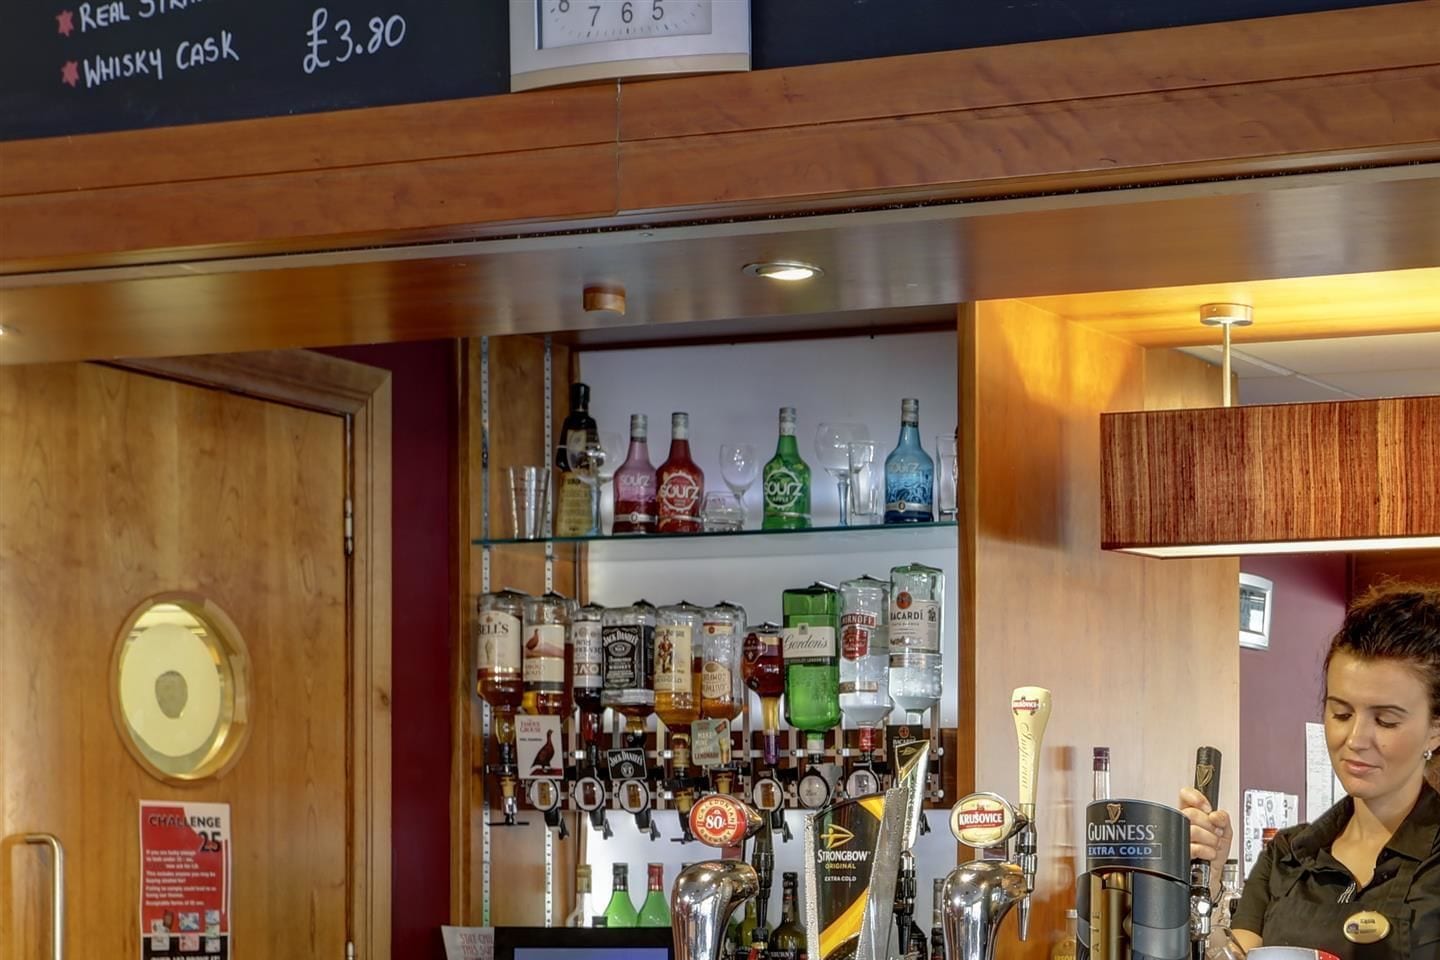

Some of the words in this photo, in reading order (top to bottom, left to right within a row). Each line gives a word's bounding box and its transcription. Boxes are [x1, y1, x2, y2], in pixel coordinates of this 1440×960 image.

[80, 2, 131, 33] REAL
[588, 6, 601, 26] 7
[621, 2, 633, 24] 6
[652, 0, 664, 21] 5
[303, 7, 406, 75] £3.80
[83, 48, 164, 89] WHISKY
[176, 30, 240, 71] CASK
[783, 631, 829, 651] Gordon's
[149, 815, 222, 829] CHALLENGE
[959, 812, 1003, 826] KRUŠOVICE
[199, 831, 223, 852] 25
[1087, 825, 1155, 842] GUINNESS
[817, 849, 867, 864] STRONGBOW
[1087, 846, 1116, 857] EXTRA
[1118, 845, 1153, 856] COLD
[825, 862, 857, 870] ORIGINAL
